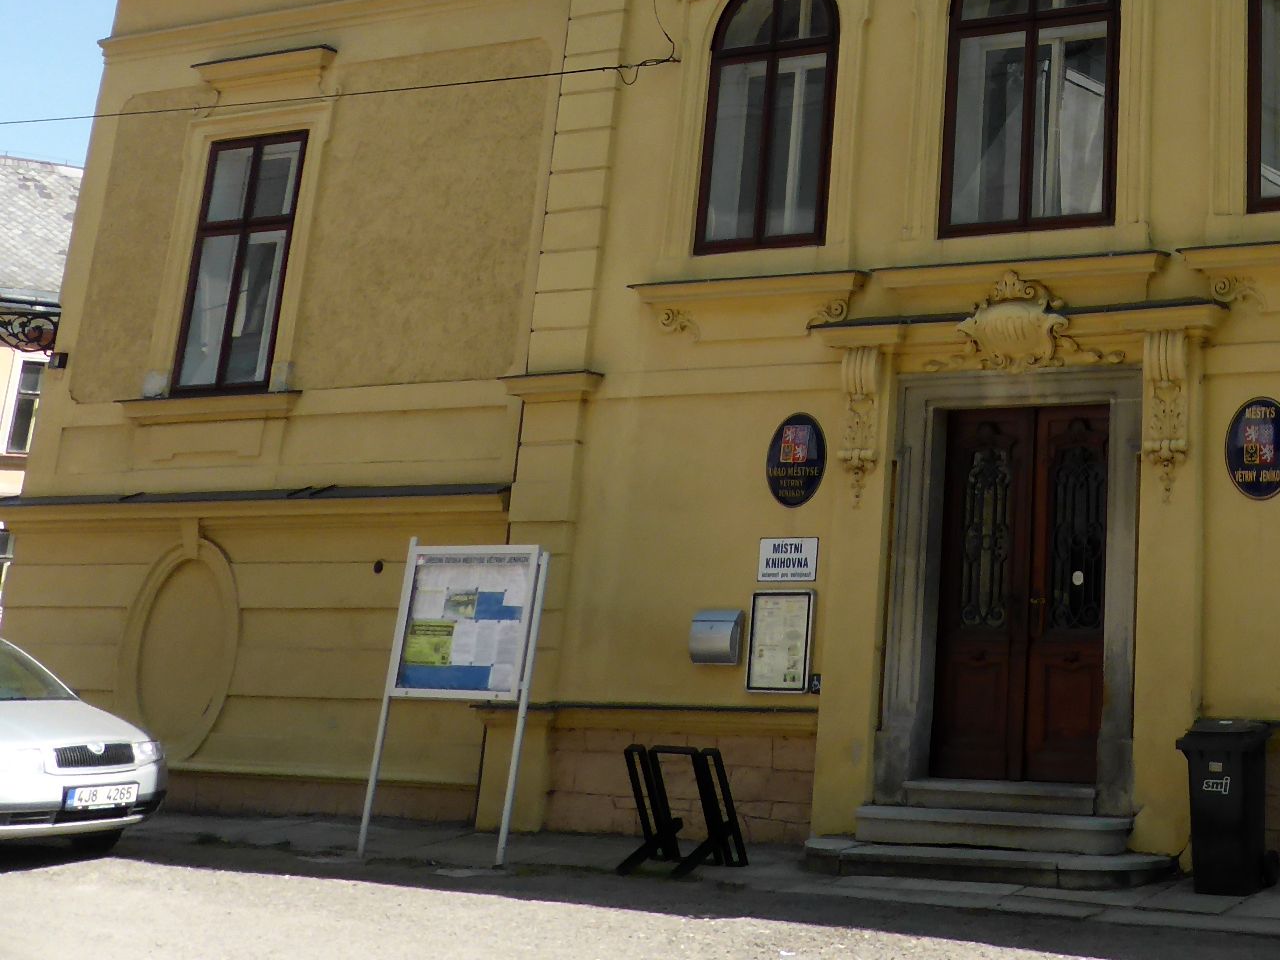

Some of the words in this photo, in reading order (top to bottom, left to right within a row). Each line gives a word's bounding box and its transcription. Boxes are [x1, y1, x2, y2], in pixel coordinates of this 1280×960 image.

[772, 540, 803, 554] MÍSTNÍ
[765, 556, 809, 569] KNIHOVNA
[106, 786, 133, 801] 4265
